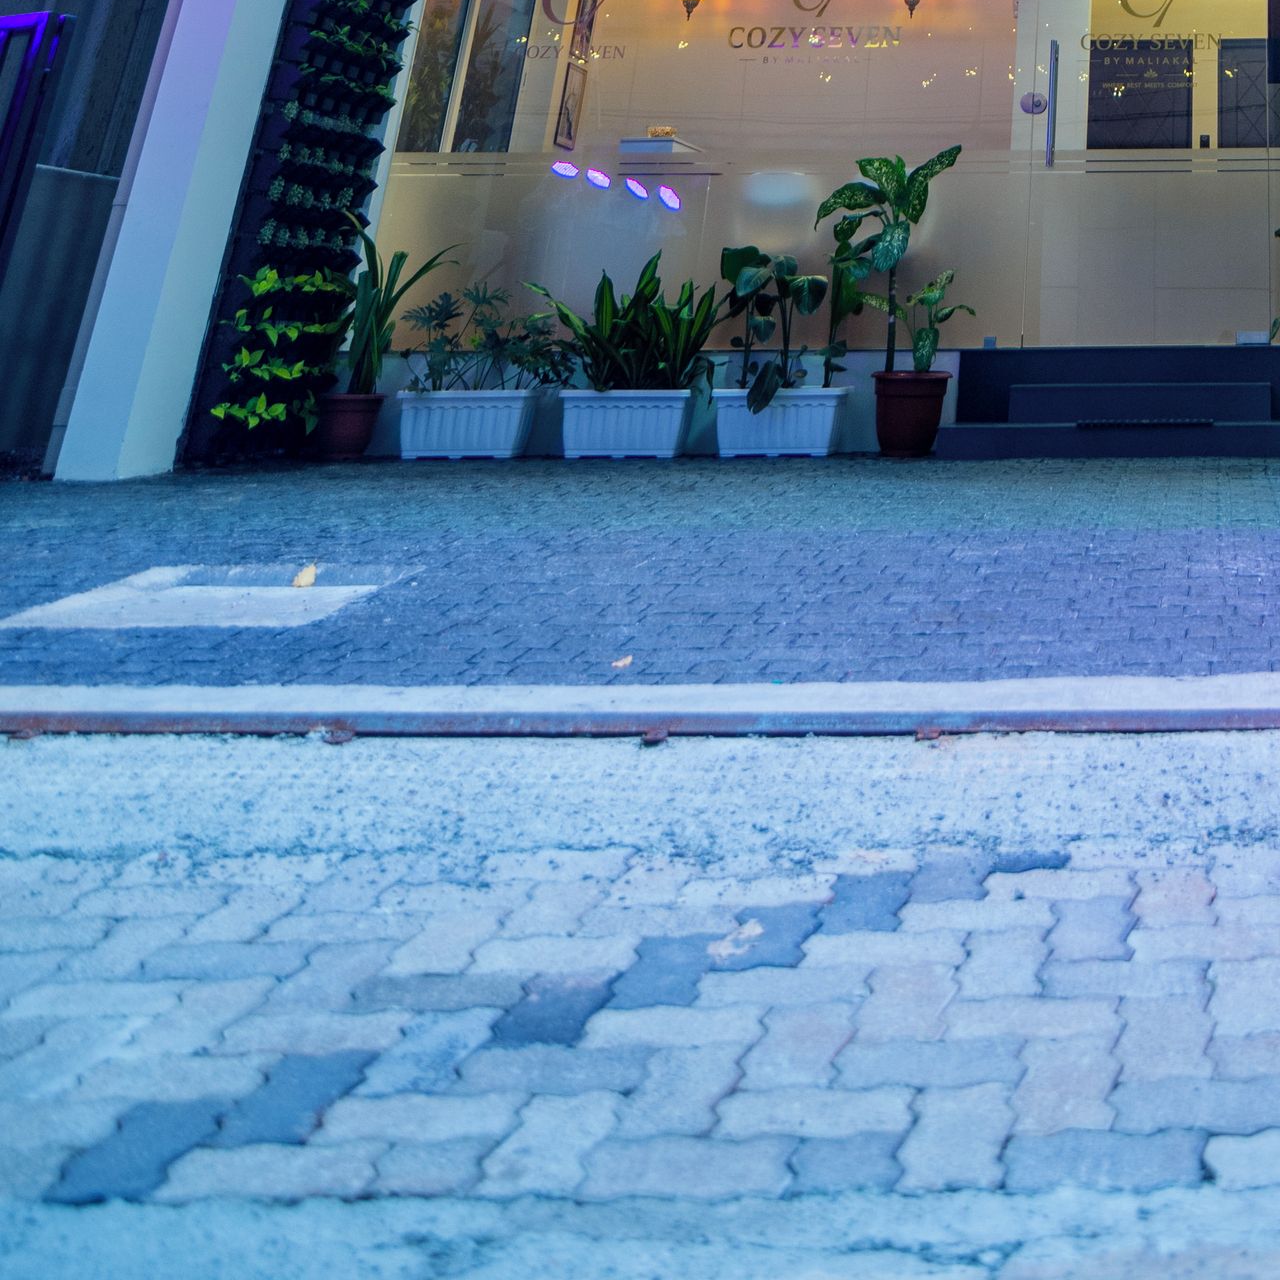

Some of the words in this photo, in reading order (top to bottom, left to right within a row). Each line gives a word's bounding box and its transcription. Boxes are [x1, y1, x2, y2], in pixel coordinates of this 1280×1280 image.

[728, 26, 807, 49] COZY
[810, 26, 903, 49] SEVEN
[1080, 33, 1145, 51] COZY
[1150, 33, 1222, 51] SEVEN
[1104, 56, 1120, 65] BY
[1125, 56, 1198, 65] MALIAKAL
